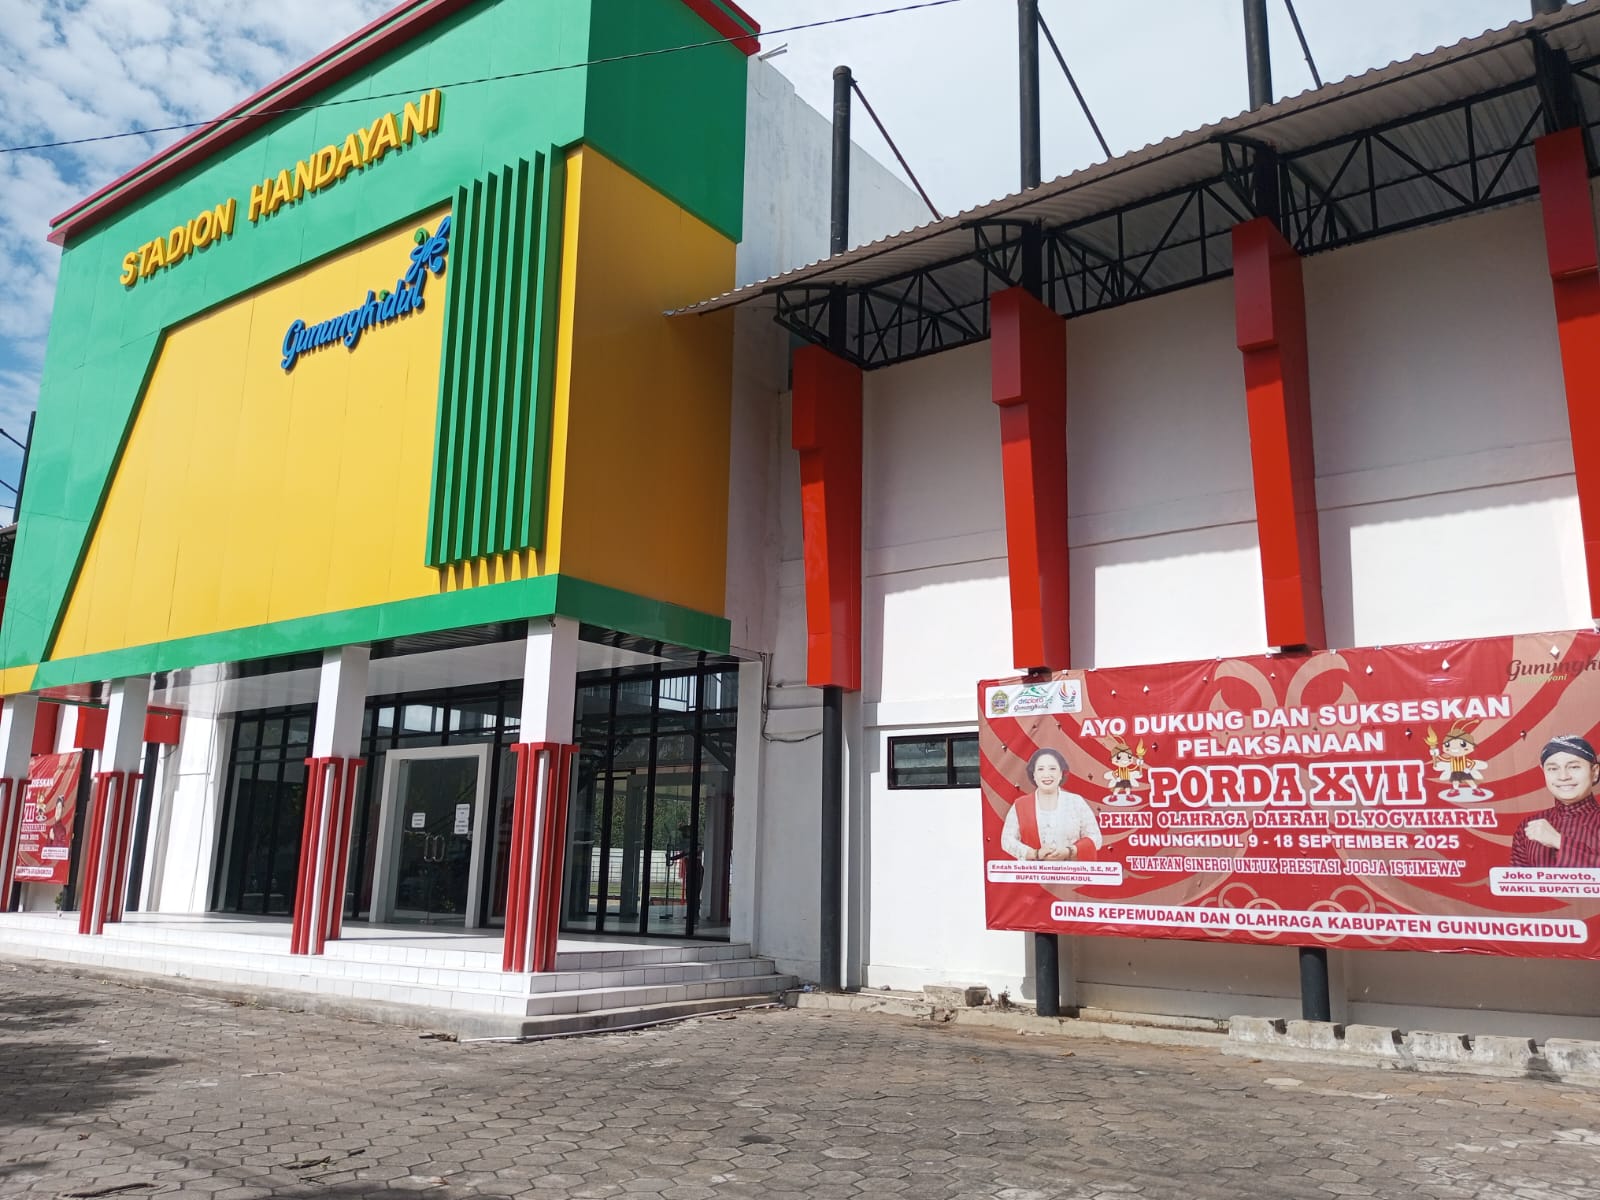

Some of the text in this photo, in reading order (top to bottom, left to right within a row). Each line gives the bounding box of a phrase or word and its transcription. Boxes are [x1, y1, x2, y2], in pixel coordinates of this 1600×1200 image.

[119, 88, 442, 286] STADION HANDAYANI
[280, 268, 428, 369] Gunungkidul
[1080, 696, 1511, 737] AYO DUKUNG DAN SUKSESKAN
[1177, 731, 1385, 758] PELAKSANAAN
[1149, 760, 1427, 808] PORDA XVII
[1099, 811, 1152, 829] PEKAN
[1157, 811, 1249, 828] OLAHRAGA
[1253, 810, 1329, 828] DAERAH
[1128, 834, 1244, 848] GUNUNGKIDUL
[1248, 835, 1258, 848] 9
[1273, 835, 1293, 848] 18
[1298, 834, 1408, 849] SEPTEMBER
[1414, 835, 1460, 849] 2025
[1126, 856, 1466, 877] "KUATKAN SINERGI UNTUK PRESTASI JOGJA ISTIMEWA"
[1502, 872, 1596, 881] Joko Parwoto,
[1499, 885, 1535, 893] WAKIL
[1539, 886, 1579, 894] BUPATI
[1054, 905, 1581, 939] DINAS KEPEMUDAAN DAN OLAHRAGA KABUPATEN GUNUNGKIDUL
